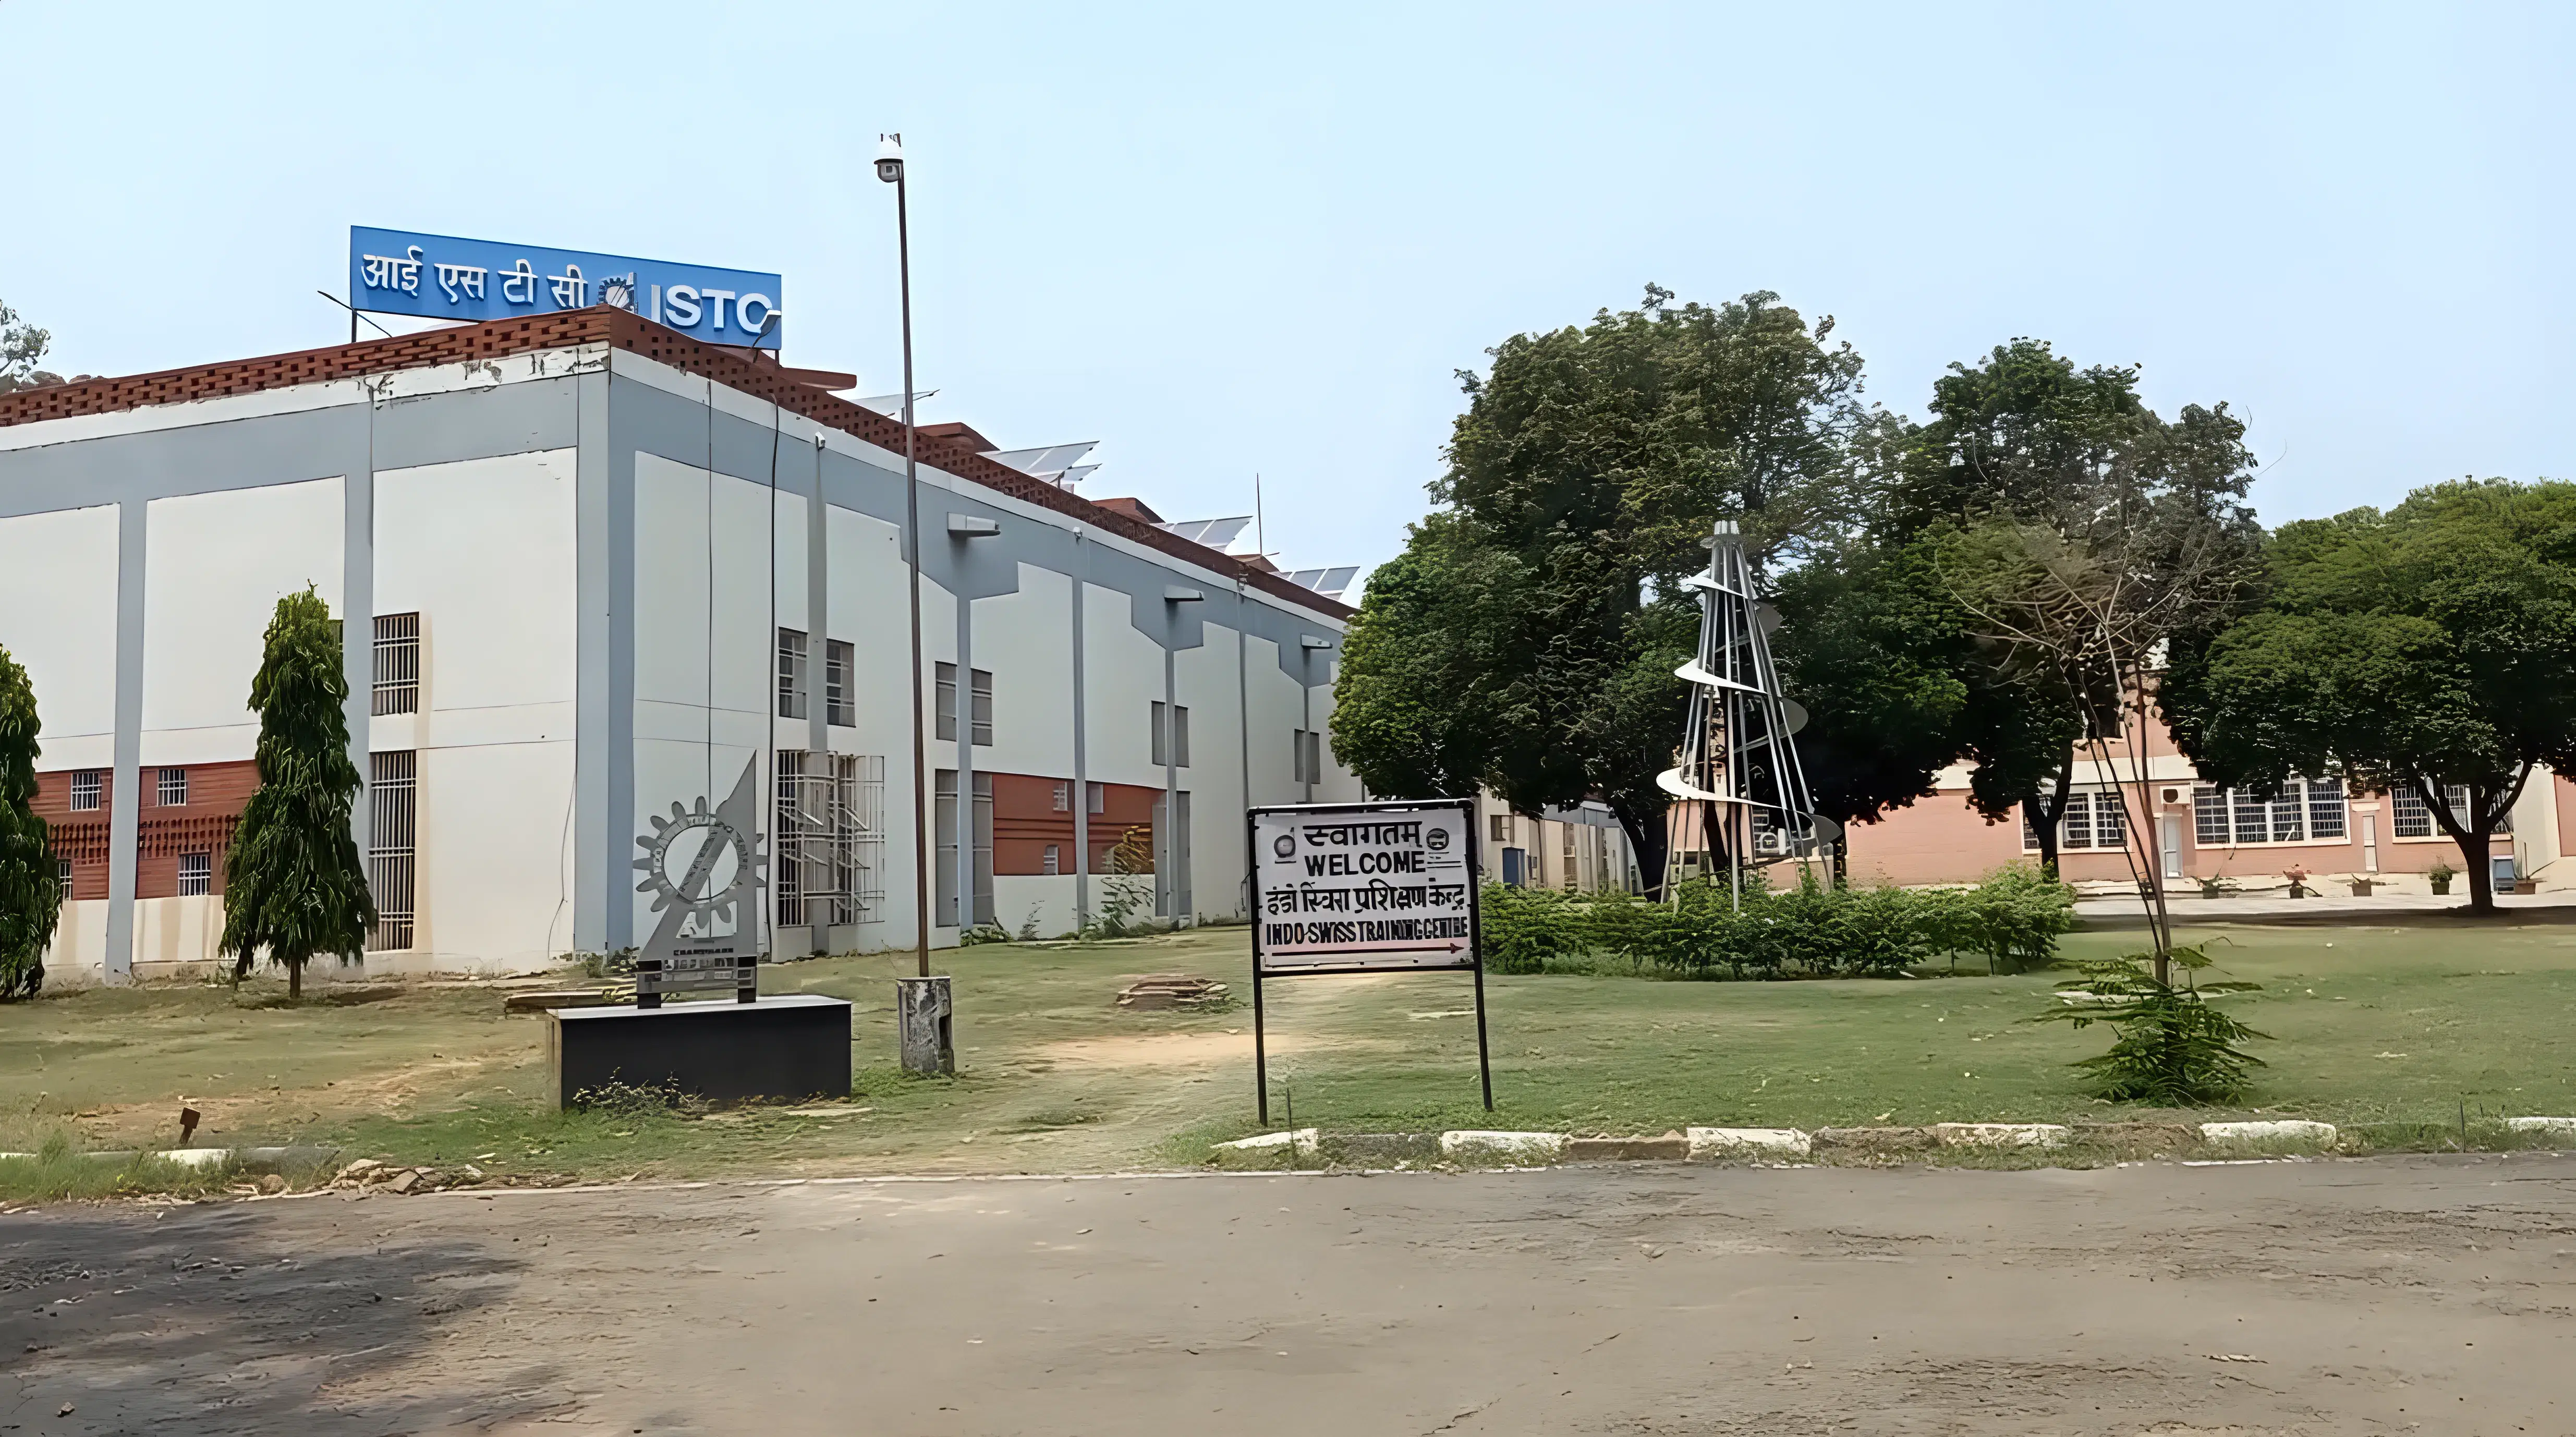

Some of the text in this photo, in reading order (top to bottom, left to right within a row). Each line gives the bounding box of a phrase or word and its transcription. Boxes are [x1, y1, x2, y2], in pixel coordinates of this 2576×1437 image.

[361, 245, 588, 309] आई एस टी सी
[651, 284, 773, 334] ISTC
[1304, 850, 1426, 876] WELCOME
